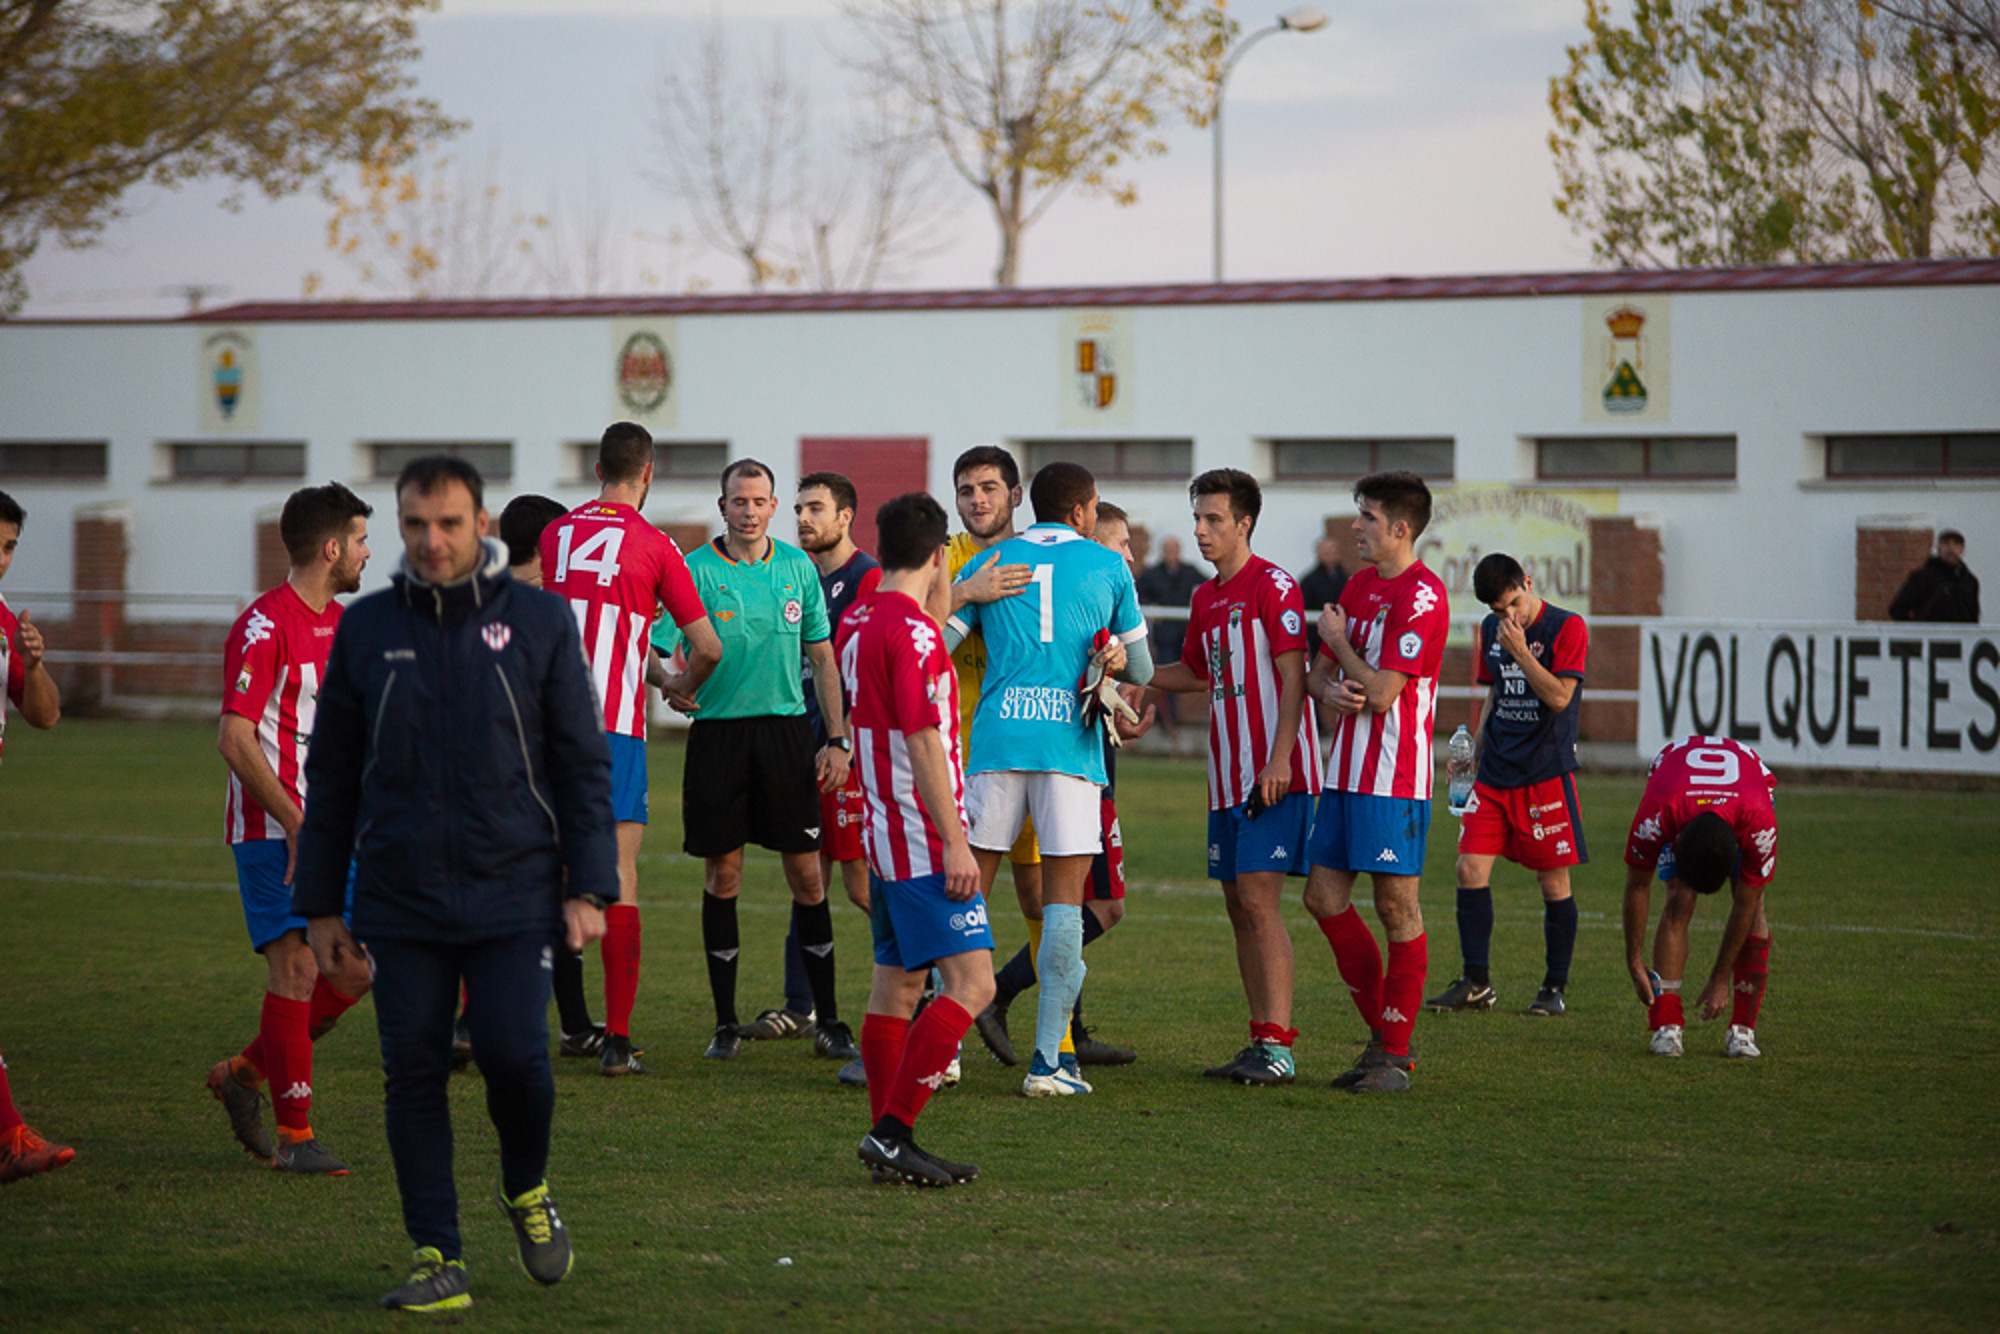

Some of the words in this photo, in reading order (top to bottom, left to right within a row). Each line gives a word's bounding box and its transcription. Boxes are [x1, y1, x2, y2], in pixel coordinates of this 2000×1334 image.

[555, 525, 625, 587] 14
[1031, 563, 1054, 643] 1
[841, 631, 860, 708] 4
[963, 653, 985, 669] CA
[1004, 685, 1075, 702] DEPORTES
[1504, 679, 1525, 695] NB
[1652, 633, 2000, 754] VOLQUETES
[999, 698, 1076, 724] SYDNEY
